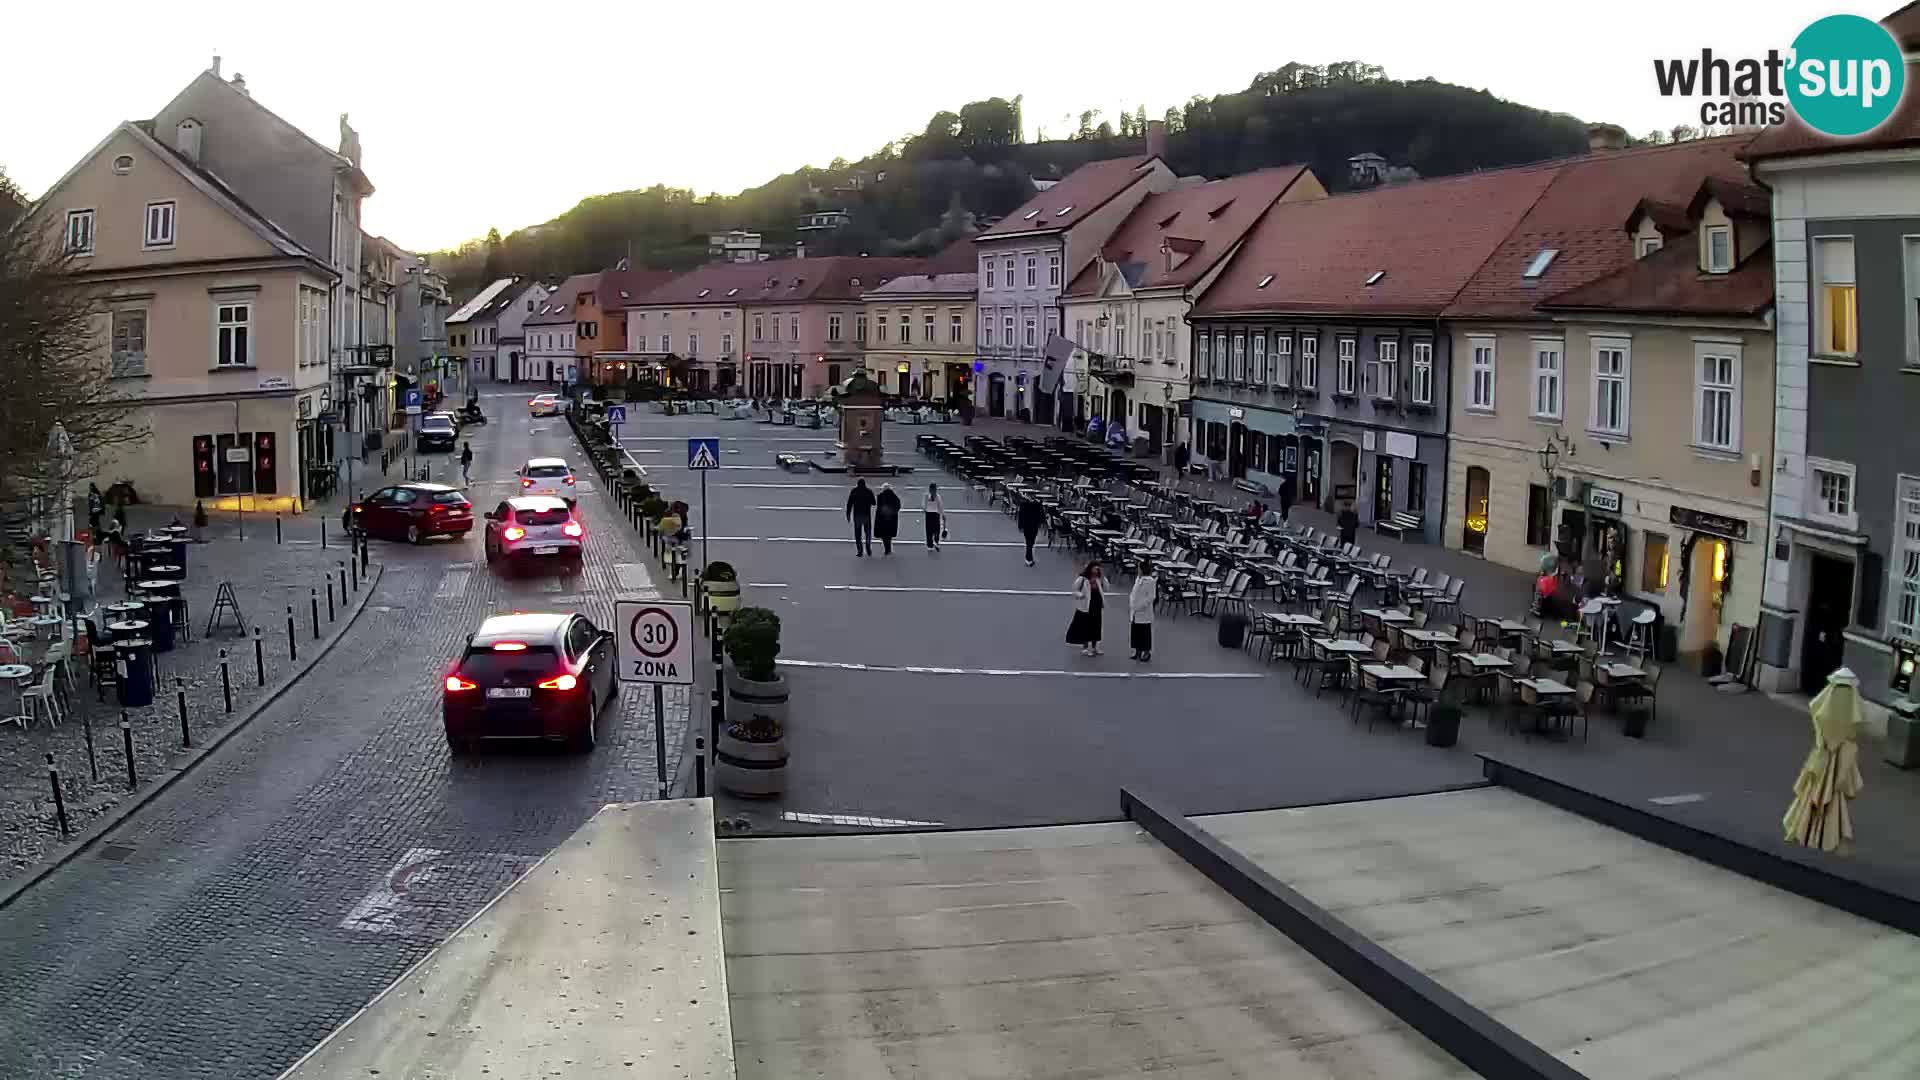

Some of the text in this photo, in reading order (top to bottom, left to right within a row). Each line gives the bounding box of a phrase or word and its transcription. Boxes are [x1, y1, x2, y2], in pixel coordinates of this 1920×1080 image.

[409, 392, 418, 404] P
[643, 623, 667, 645] 30
[633, 660, 678, 677] ZONA
